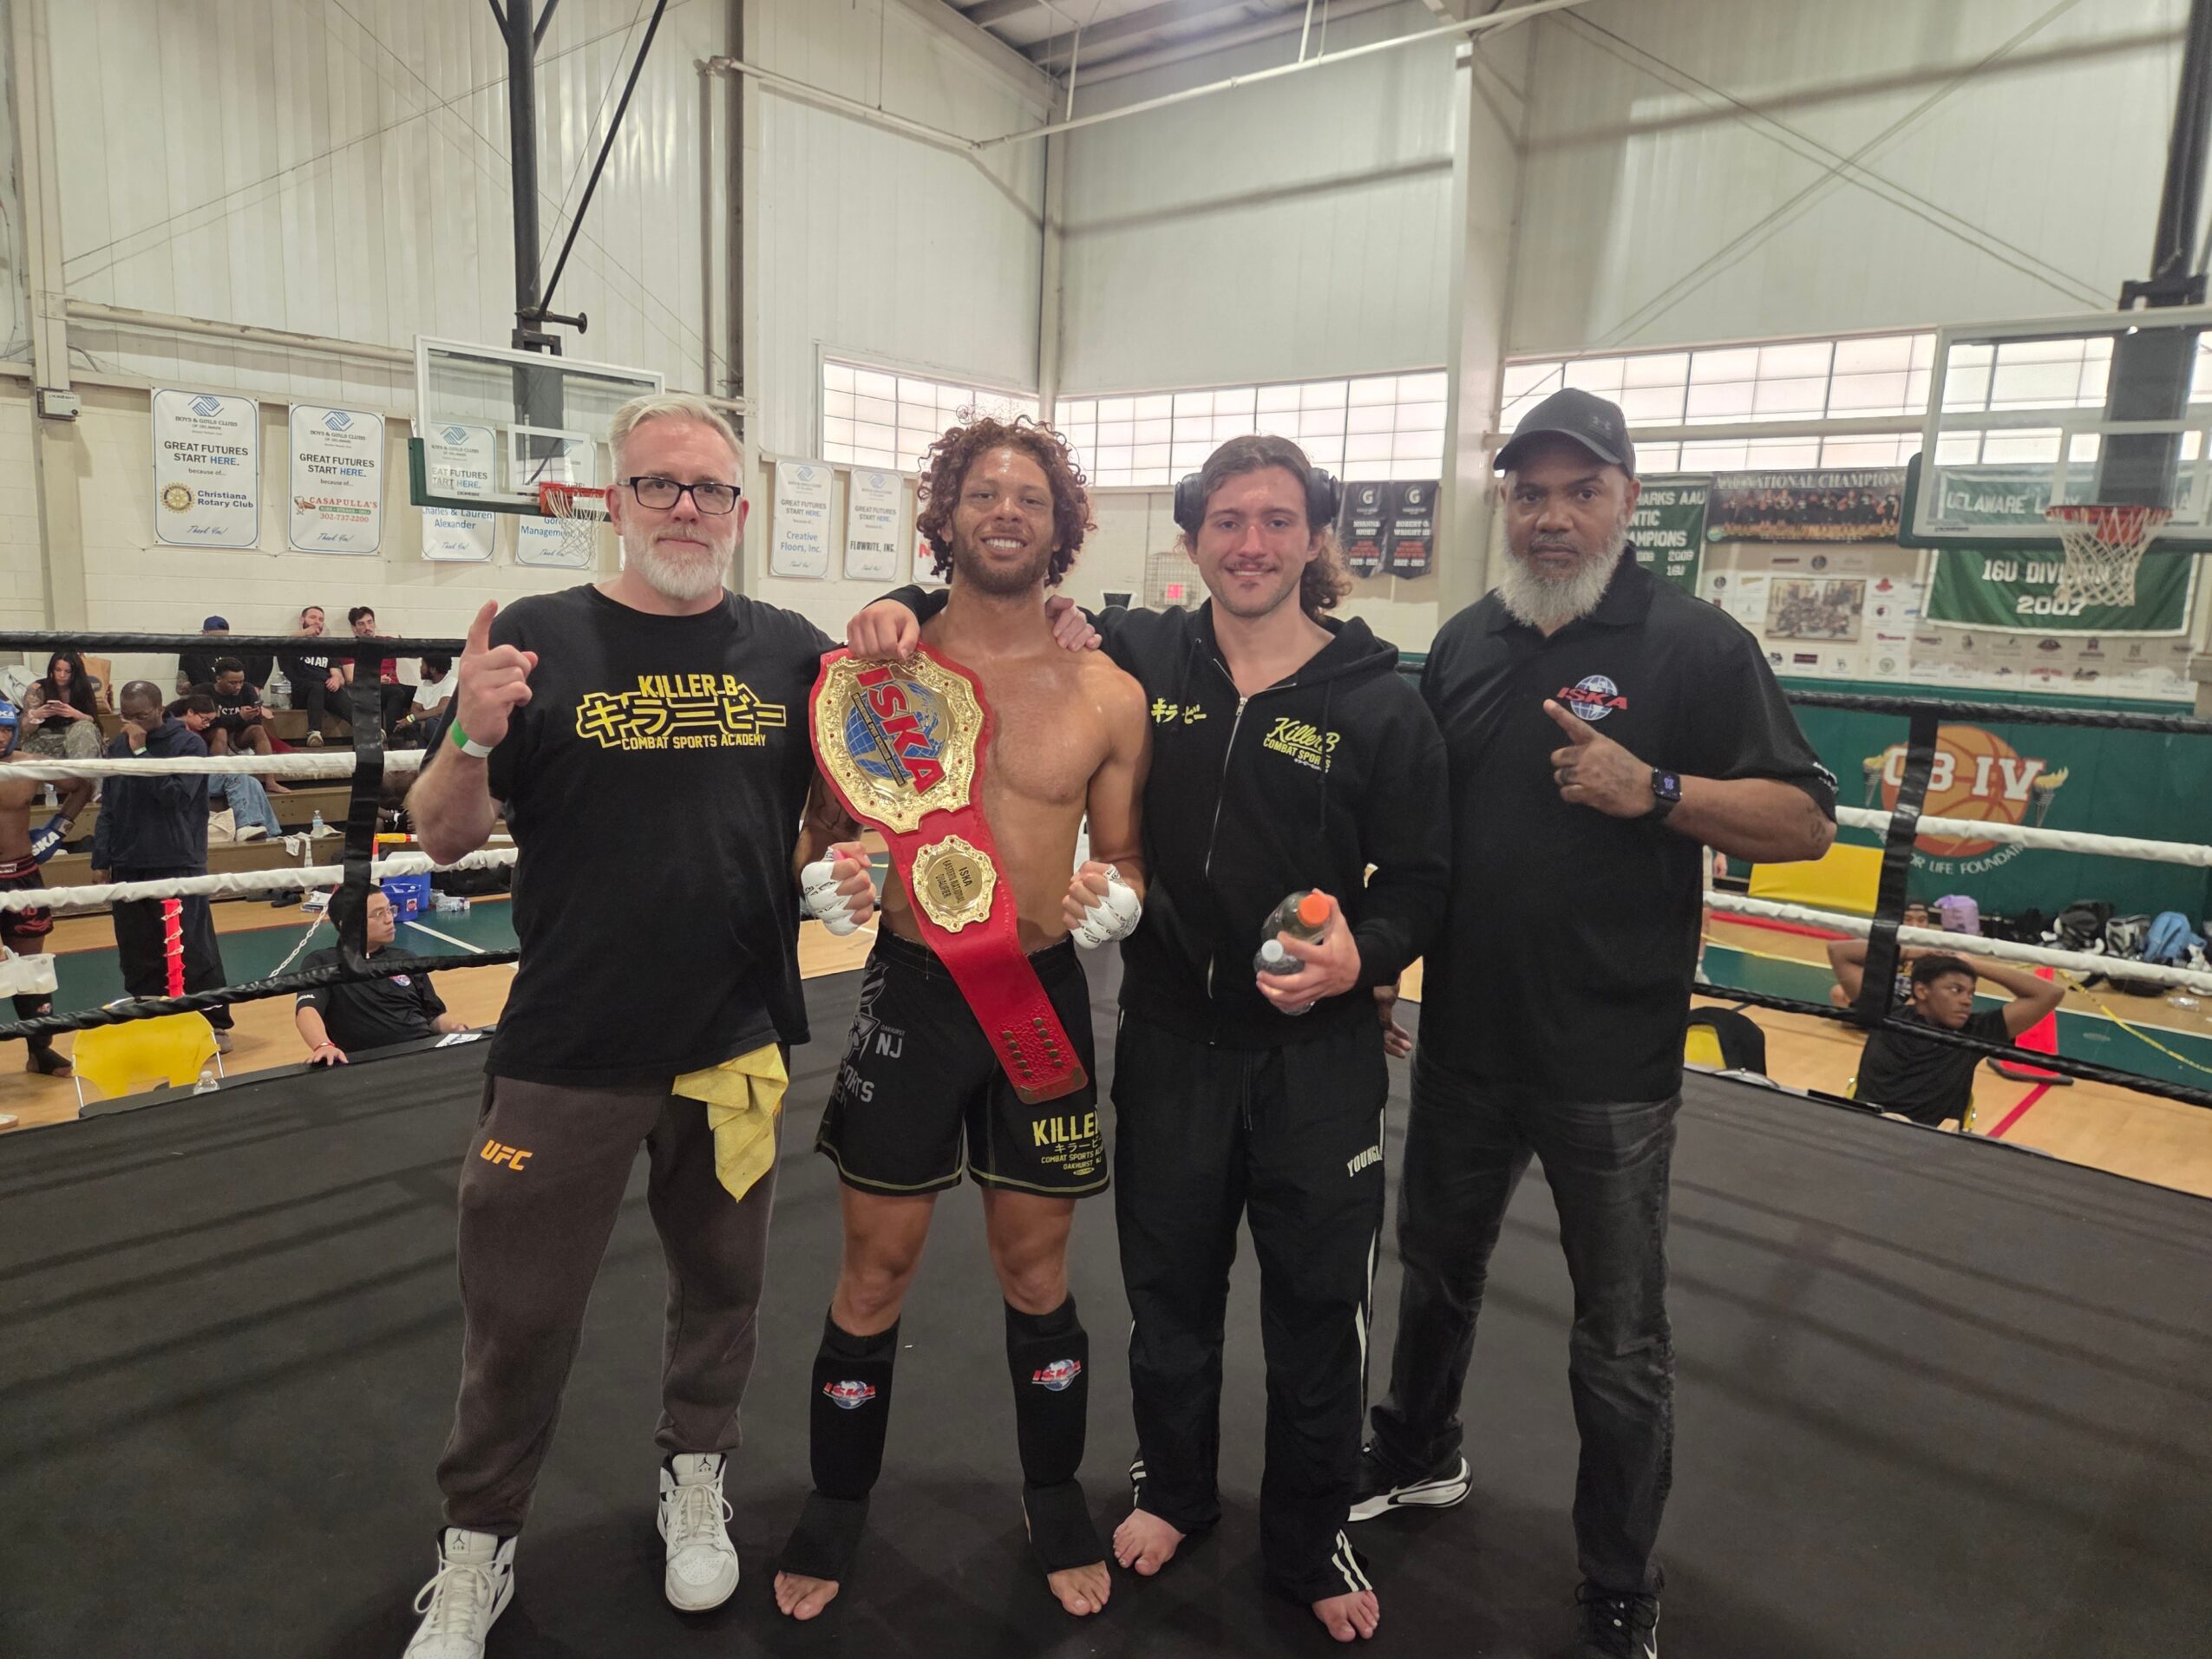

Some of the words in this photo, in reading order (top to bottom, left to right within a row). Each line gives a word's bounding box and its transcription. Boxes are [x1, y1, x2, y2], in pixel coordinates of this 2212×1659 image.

[164, 441, 200, 452] GREAT
[201, 444, 249, 456] FUTURES
[173, 453, 207, 464] START
[210, 456, 239, 466] HERE.
[299, 453, 330, 464] GREAT
[332, 456, 375, 468] FUTURES
[308, 464, 337, 474] START
[339, 467, 367, 477] HERE.
[432, 467, 448, 476] EAT
[449, 469, 488, 480] FUTURES
[456, 480, 481, 489] HERE.
[197, 490, 247, 500] Christiana
[309, 496, 378, 508] CASAPULLA'S
[1679, 490, 1706, 506] AAU
[1946, 490, 2028, 514] DELAWARE
[197, 499, 230, 508] Rotary
[781, 499, 801, 507] GREAT
[801, 500, 827, 510] FUTURES
[854, 505, 873, 513] GREAT
[873, 506, 897, 515] FUTURES
[451, 508, 458, 517] &
[461, 509, 492, 519] Lauren
[786, 507, 805, 516] START
[1630, 510, 1661, 526] NTIC
[434, 518, 476, 530] Alexander
[786, 531, 819, 541] Creative
[1628, 530, 1687, 547] AMPIONS
[780, 541, 807, 553] Floors,
[1981, 558, 2019, 583] 16U
[2016, 594, 2087, 617] 2007
[638, 674, 718, 698] KILLER
[722, 674, 739, 696] B
[1556, 687, 1628, 710] ISKA
[855, 665, 947, 796] ISKA
[1266, 717, 1323, 748] Killer
[621, 735, 670, 751] COMBAT
[672, 735, 717, 750] SPORTS
[721, 734, 766, 747] ACADEMY
[1263, 737, 1299, 757] COMBAT
[1298, 749, 1332, 769] SPORS
[31, 831, 61, 857] SKA
[1928, 861, 1954, 875] LIFE
[959, 866, 973, 887] ISKA
[875, 1032, 903, 1059] NJ
[480, 1139, 534, 1172] UFC
[1041, 1154, 1068, 1165] COMBAT
[1069, 1151, 1095, 1161] SPORTS
[1063, 1159, 1094, 1170] OAKHURST
